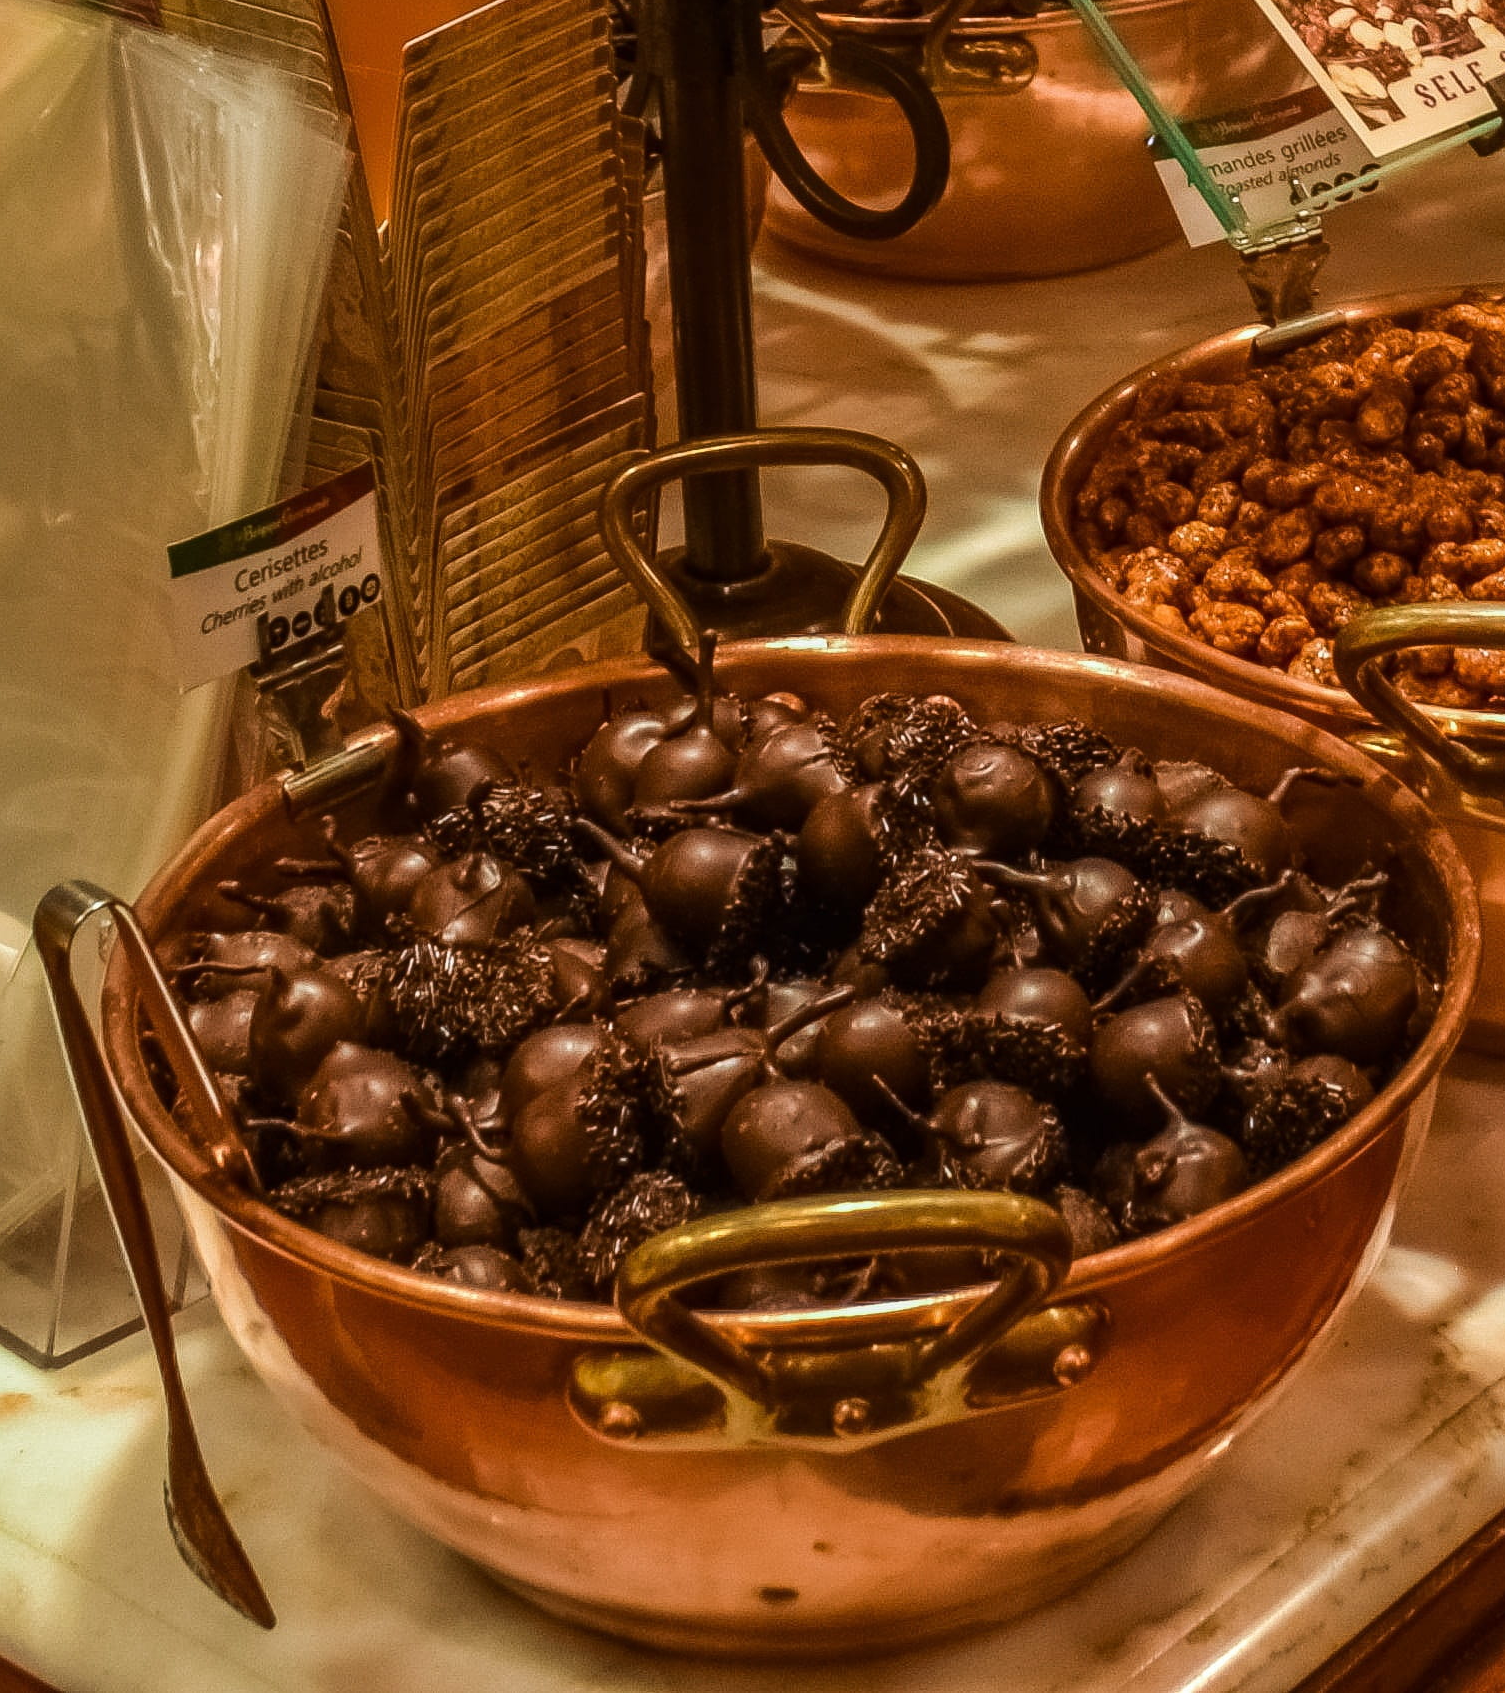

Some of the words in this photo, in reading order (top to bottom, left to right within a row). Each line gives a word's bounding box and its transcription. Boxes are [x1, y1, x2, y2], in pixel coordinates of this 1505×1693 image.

[1413, 60, 1488, 109] SELF
[1204, 148, 1276, 179] mandes
[1280, 125, 1349, 164] grillées
[200, 594, 268, 636] Cherries
[271, 574, 305, 604] with
[308, 544, 364, 588] alcohol
[234, 538, 329, 594] Cerisettes
